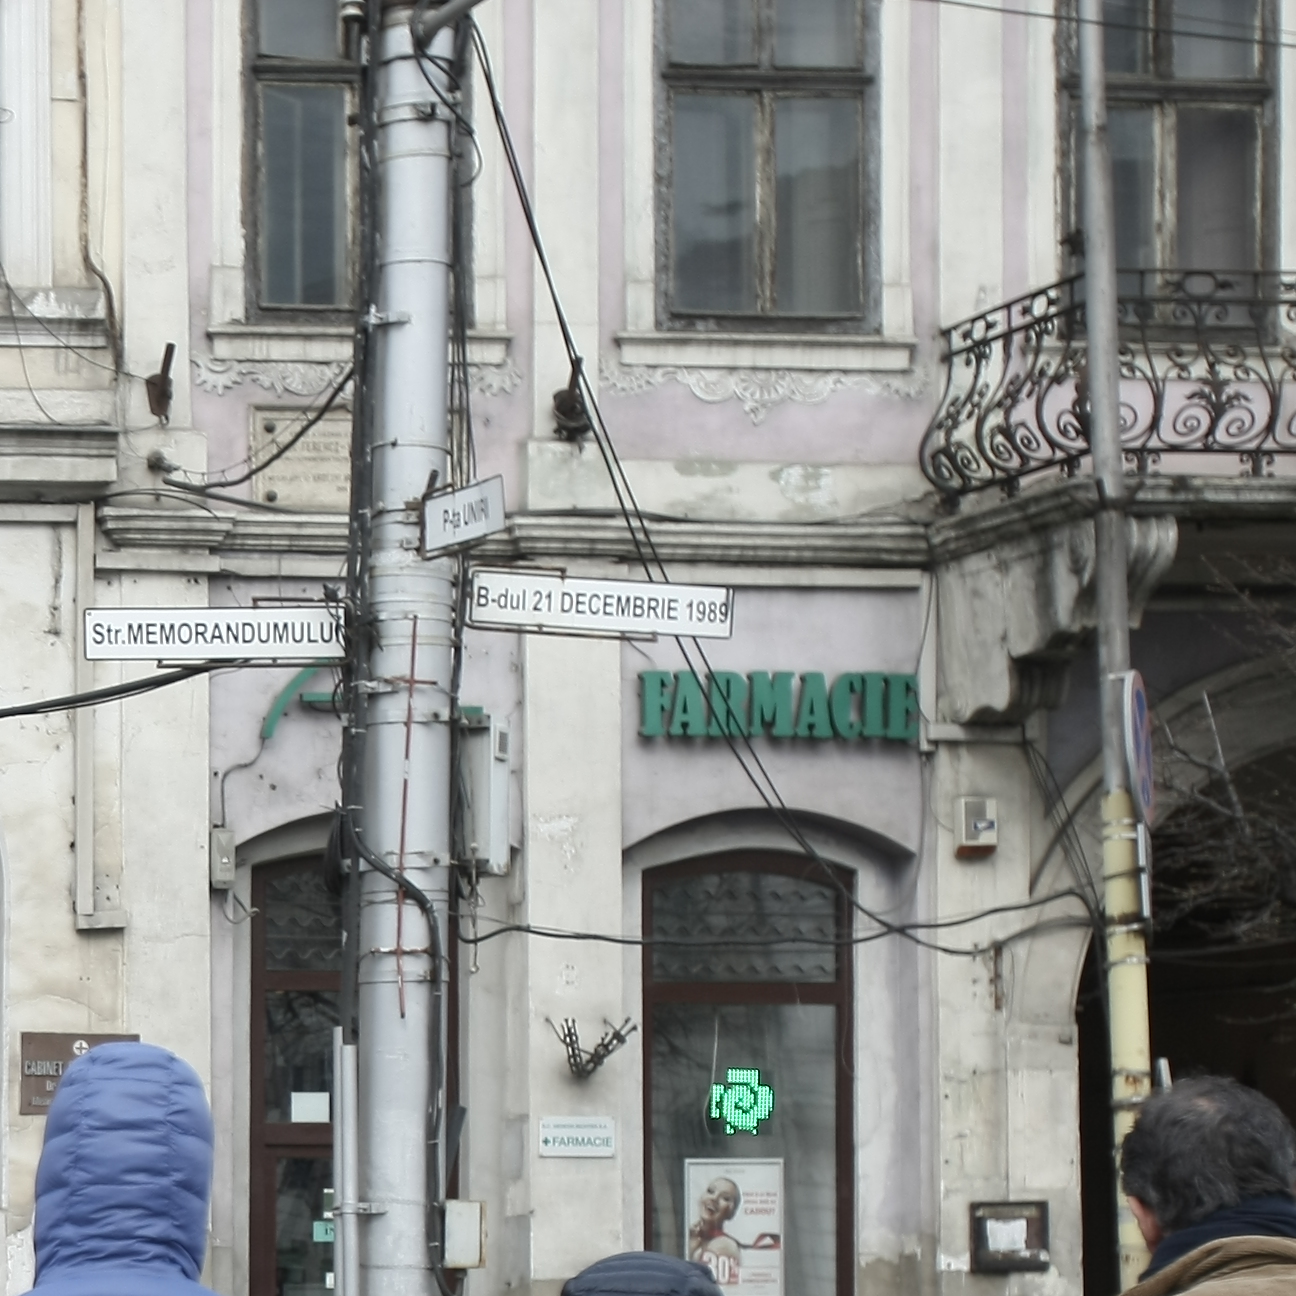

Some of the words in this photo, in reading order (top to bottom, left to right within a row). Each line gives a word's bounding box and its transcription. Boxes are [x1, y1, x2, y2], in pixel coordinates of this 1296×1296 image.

[476, 586, 527, 610] B-dul
[533, 590, 554, 612] 21
[560, 592, 679, 620] DECEMBRIE
[686, 602, 729, 624] 1989
[91, 622, 342, 645] Str.MEMORANDUMULU
[638, 670, 920, 740] FARMACIE
[24, 1060, 64, 1076] CABINET
[551, 1136, 614, 1147] FARMACIE
